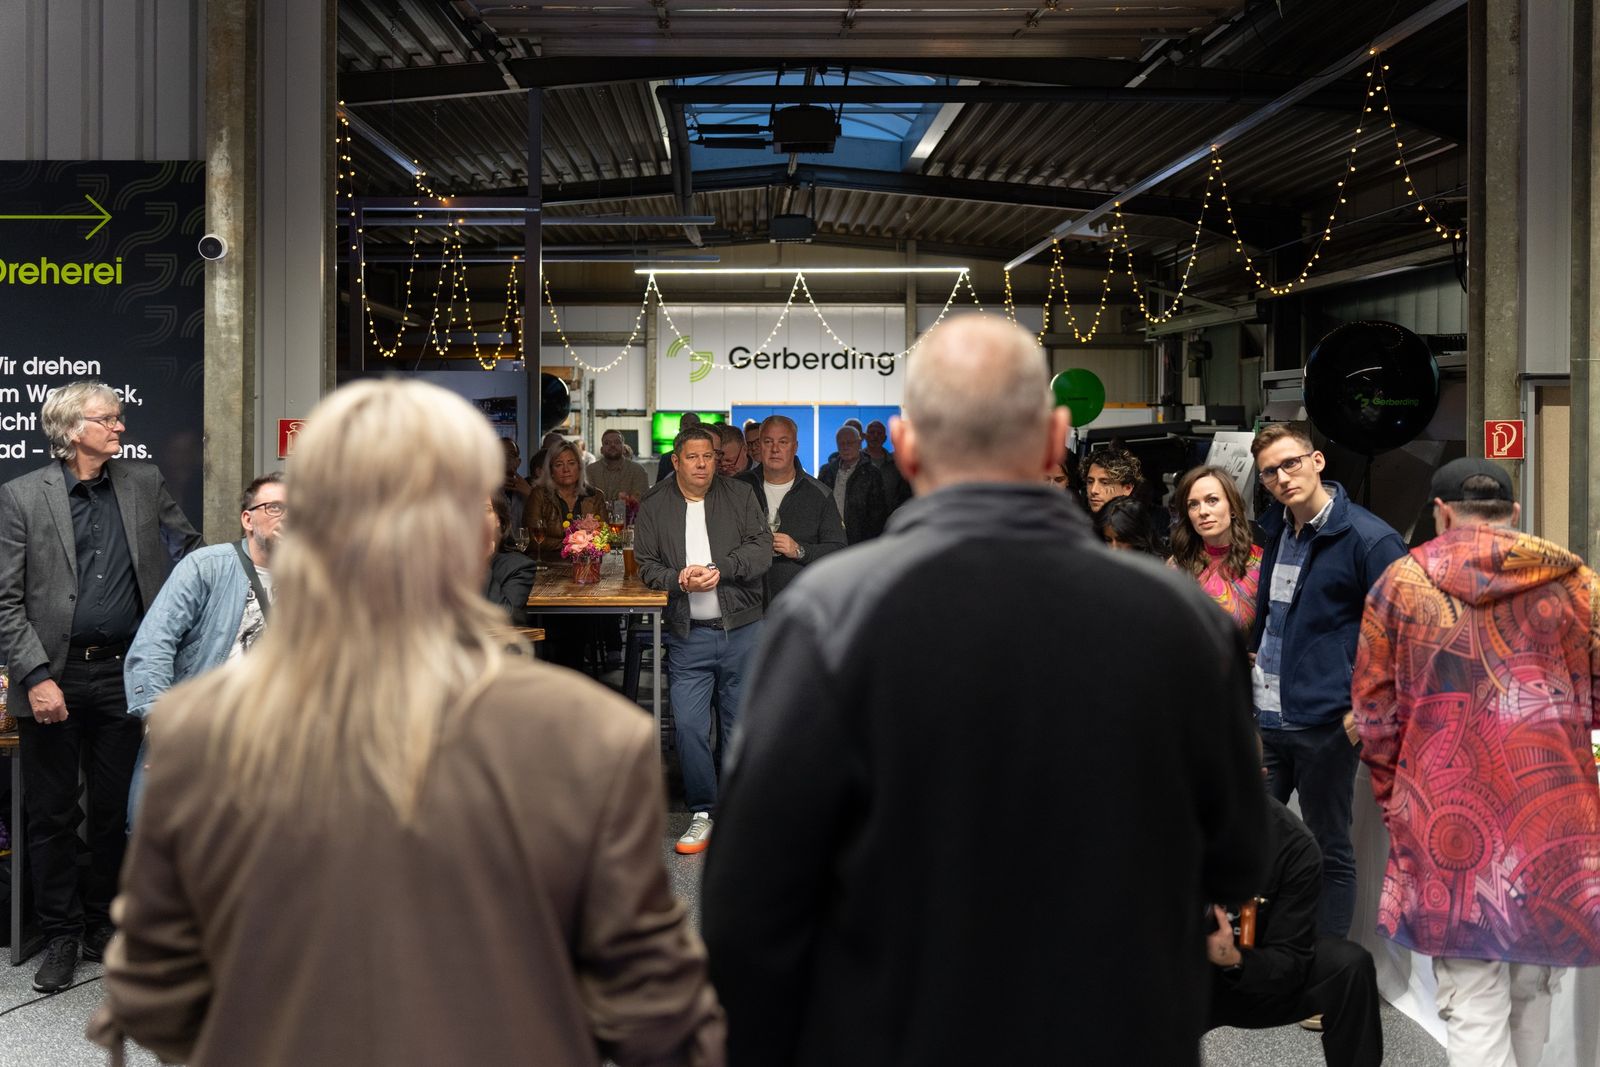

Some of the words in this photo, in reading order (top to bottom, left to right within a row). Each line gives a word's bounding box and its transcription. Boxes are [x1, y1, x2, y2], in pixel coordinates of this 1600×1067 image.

[0, 356, 16, 374] ir
[23, 356, 101, 375] drehen
[729, 346, 895, 376] Gerberding
